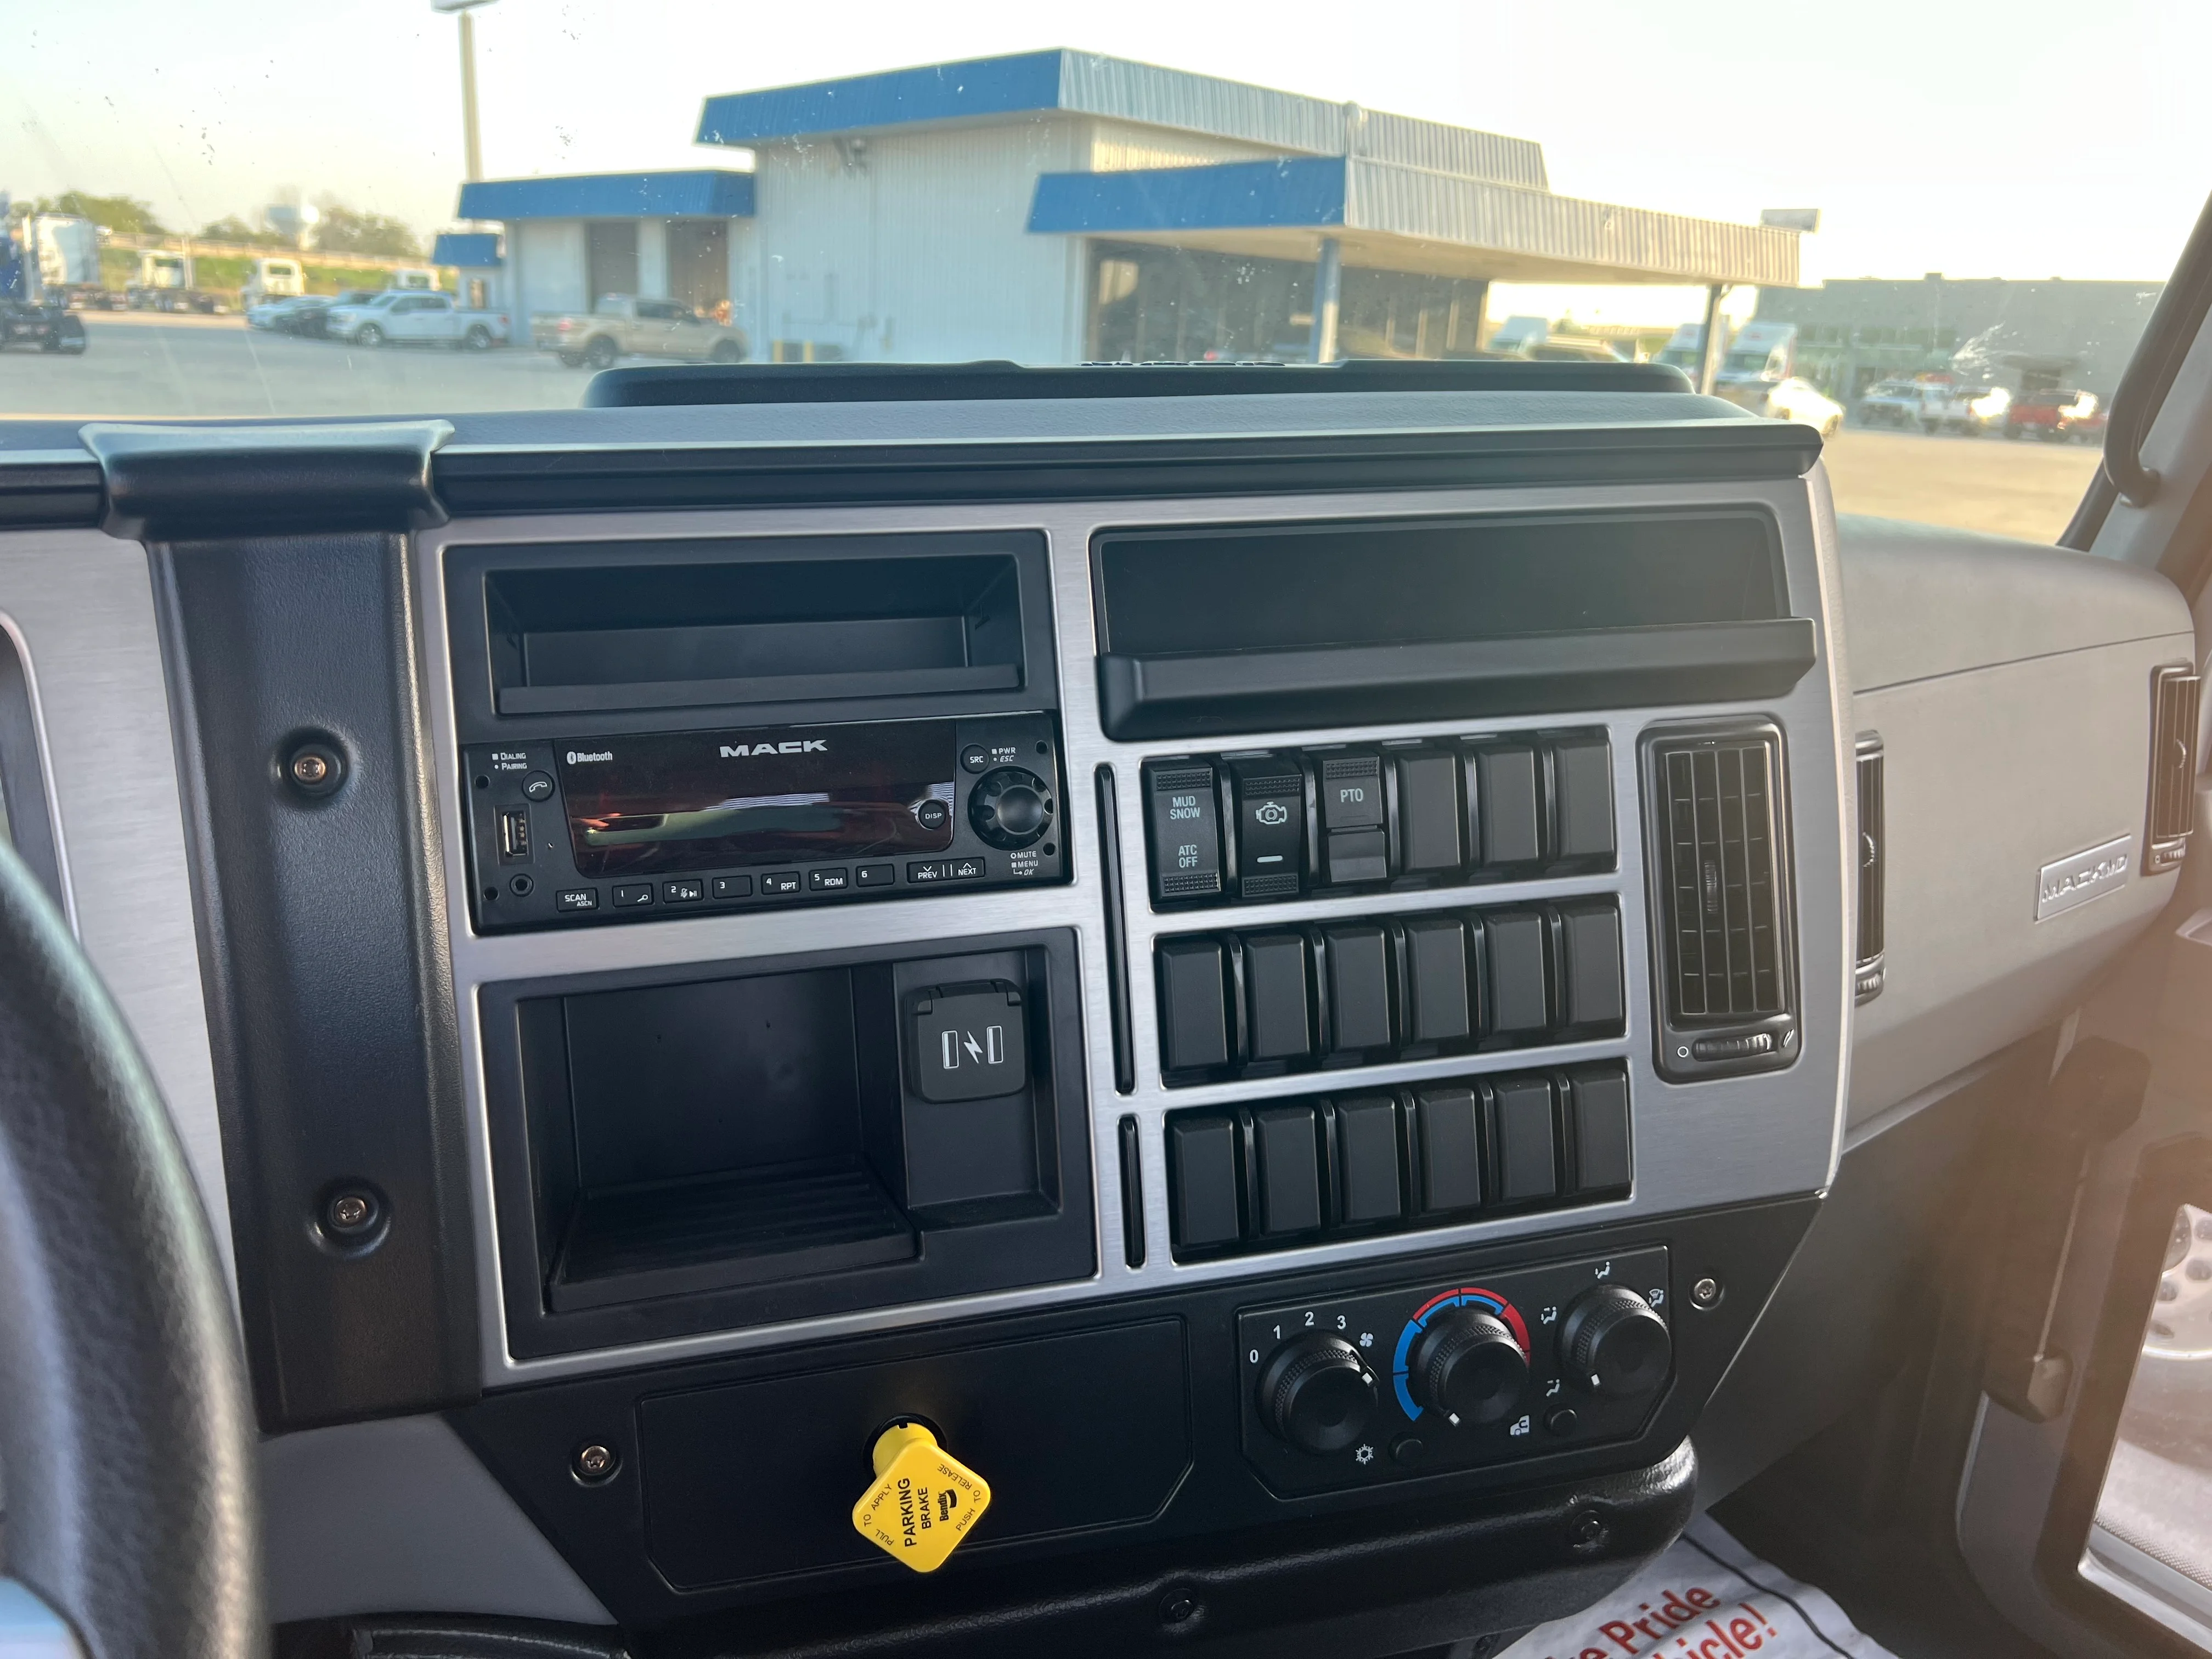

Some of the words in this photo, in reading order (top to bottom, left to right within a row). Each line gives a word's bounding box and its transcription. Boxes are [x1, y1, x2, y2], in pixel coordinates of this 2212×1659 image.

[719, 740, 828, 758] MACK
[577, 751, 613, 762] Bluetooth
[1172, 795, 1196, 808] MUD
[1340, 788, 1364, 803] PTO
[1170, 807, 1200, 820] SNOW
[1178, 844, 1198, 856] ATC
[1178, 856, 1198, 868] OFF
[958, 867, 977, 876] NEXT
[781, 882, 797, 890] RPT
[824, 878, 843, 886] RDM
[565, 893, 586, 902] SCAN
[1249, 1349, 1259, 1363] 0
[1273, 1325, 1281, 1339] 1
[1305, 1311, 1314, 1326] 2
[1337, 1315, 1346, 1329] 3
[937, 1464, 973, 1491] RELEASE
[871, 1483, 893, 1510] APPLY
[973, 1490, 981, 1503] TO
[898, 1477, 917, 1547] PARKING
[917, 1487, 932, 1530] BRAKE
[937, 1491, 949, 1522] Bendix
[863, 1514, 872, 1527] TO
[956, 1508, 975, 1531] PUSH
[875, 1529, 895, 1546] PULL
[1599, 1587, 1721, 1655] Pride
